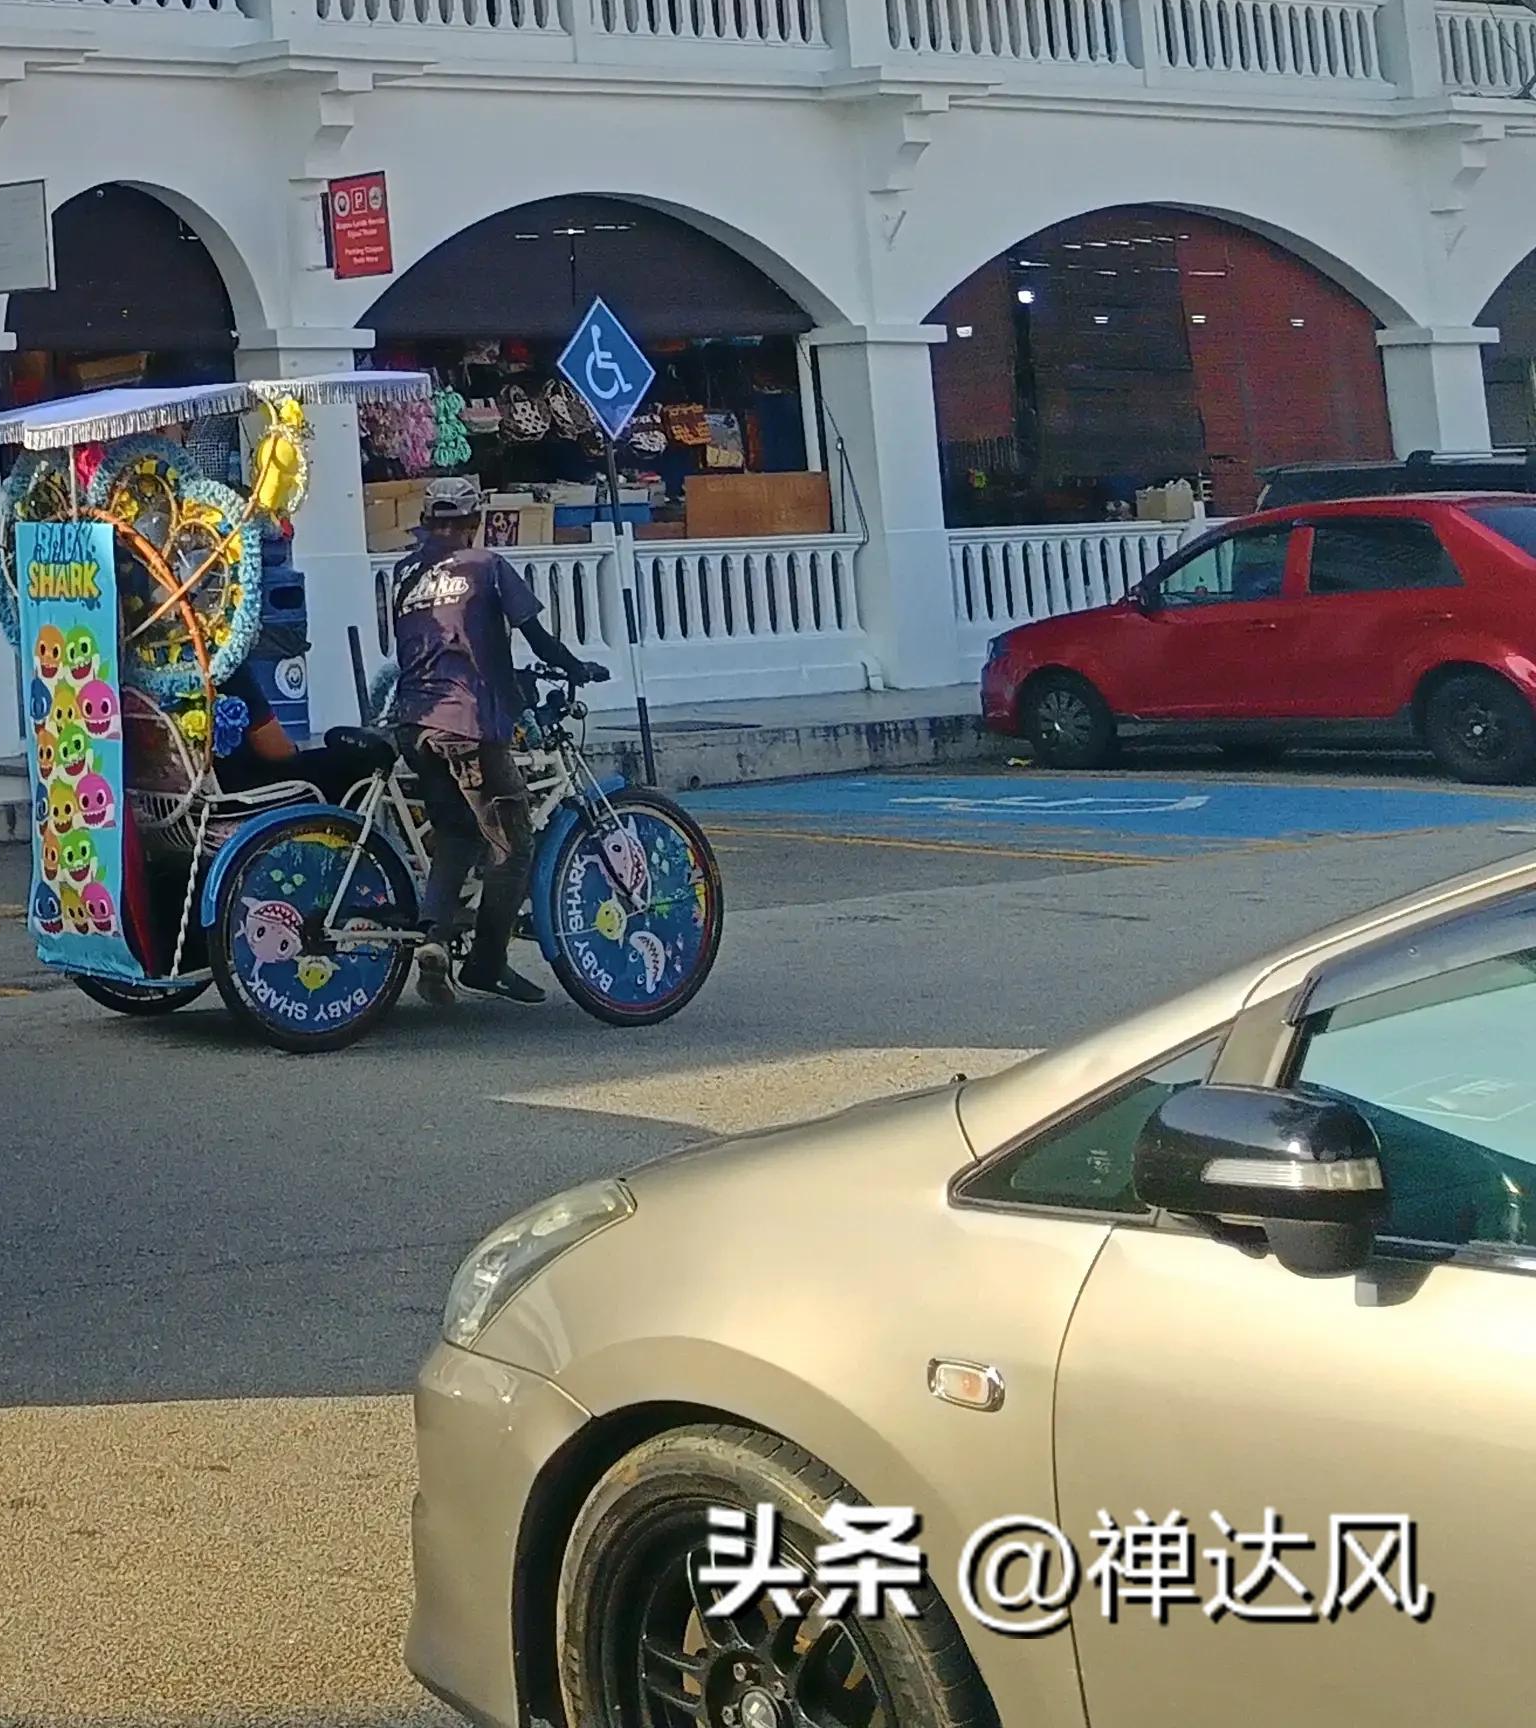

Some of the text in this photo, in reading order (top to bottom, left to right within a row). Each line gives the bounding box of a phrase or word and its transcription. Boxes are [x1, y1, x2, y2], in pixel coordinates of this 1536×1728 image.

[28, 560, 101, 600] SHARK
[566, 853, 614, 993] BABY SHARK
[246, 972, 369, 1022] BABY SHARK
